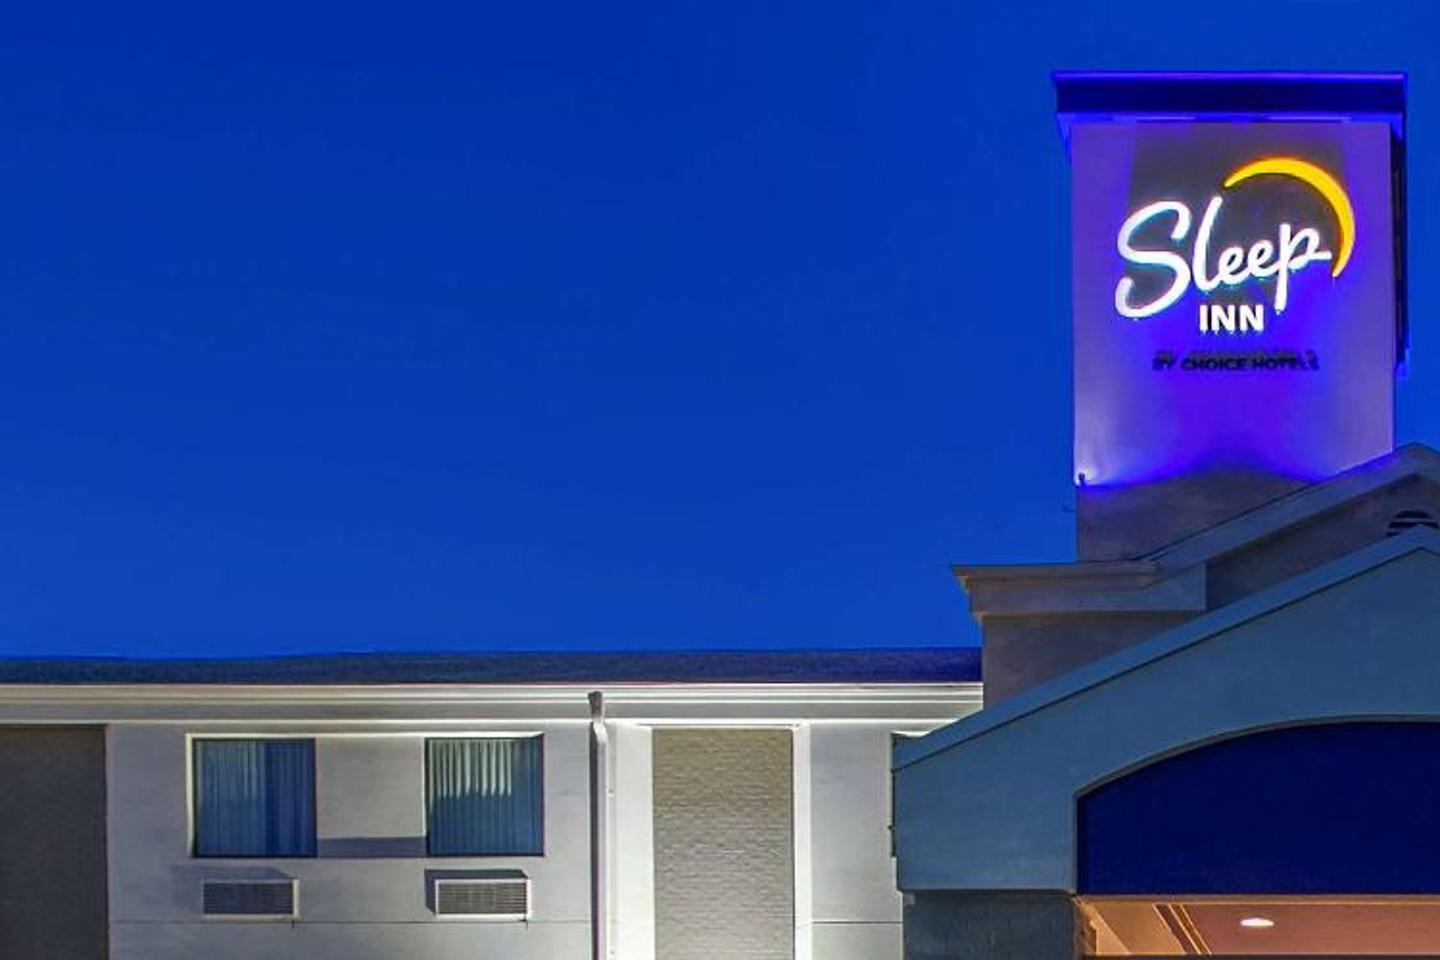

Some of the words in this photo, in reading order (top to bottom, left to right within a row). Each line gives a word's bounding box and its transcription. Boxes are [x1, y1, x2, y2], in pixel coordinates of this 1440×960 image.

[1115, 196, 1332, 318] Sleep
[1199, 304, 1264, 332] INN
[1152, 356, 1176, 371] BY
[1180, 356, 1248, 371] CHOICE
[1252, 355, 1320, 371] HOTELS
